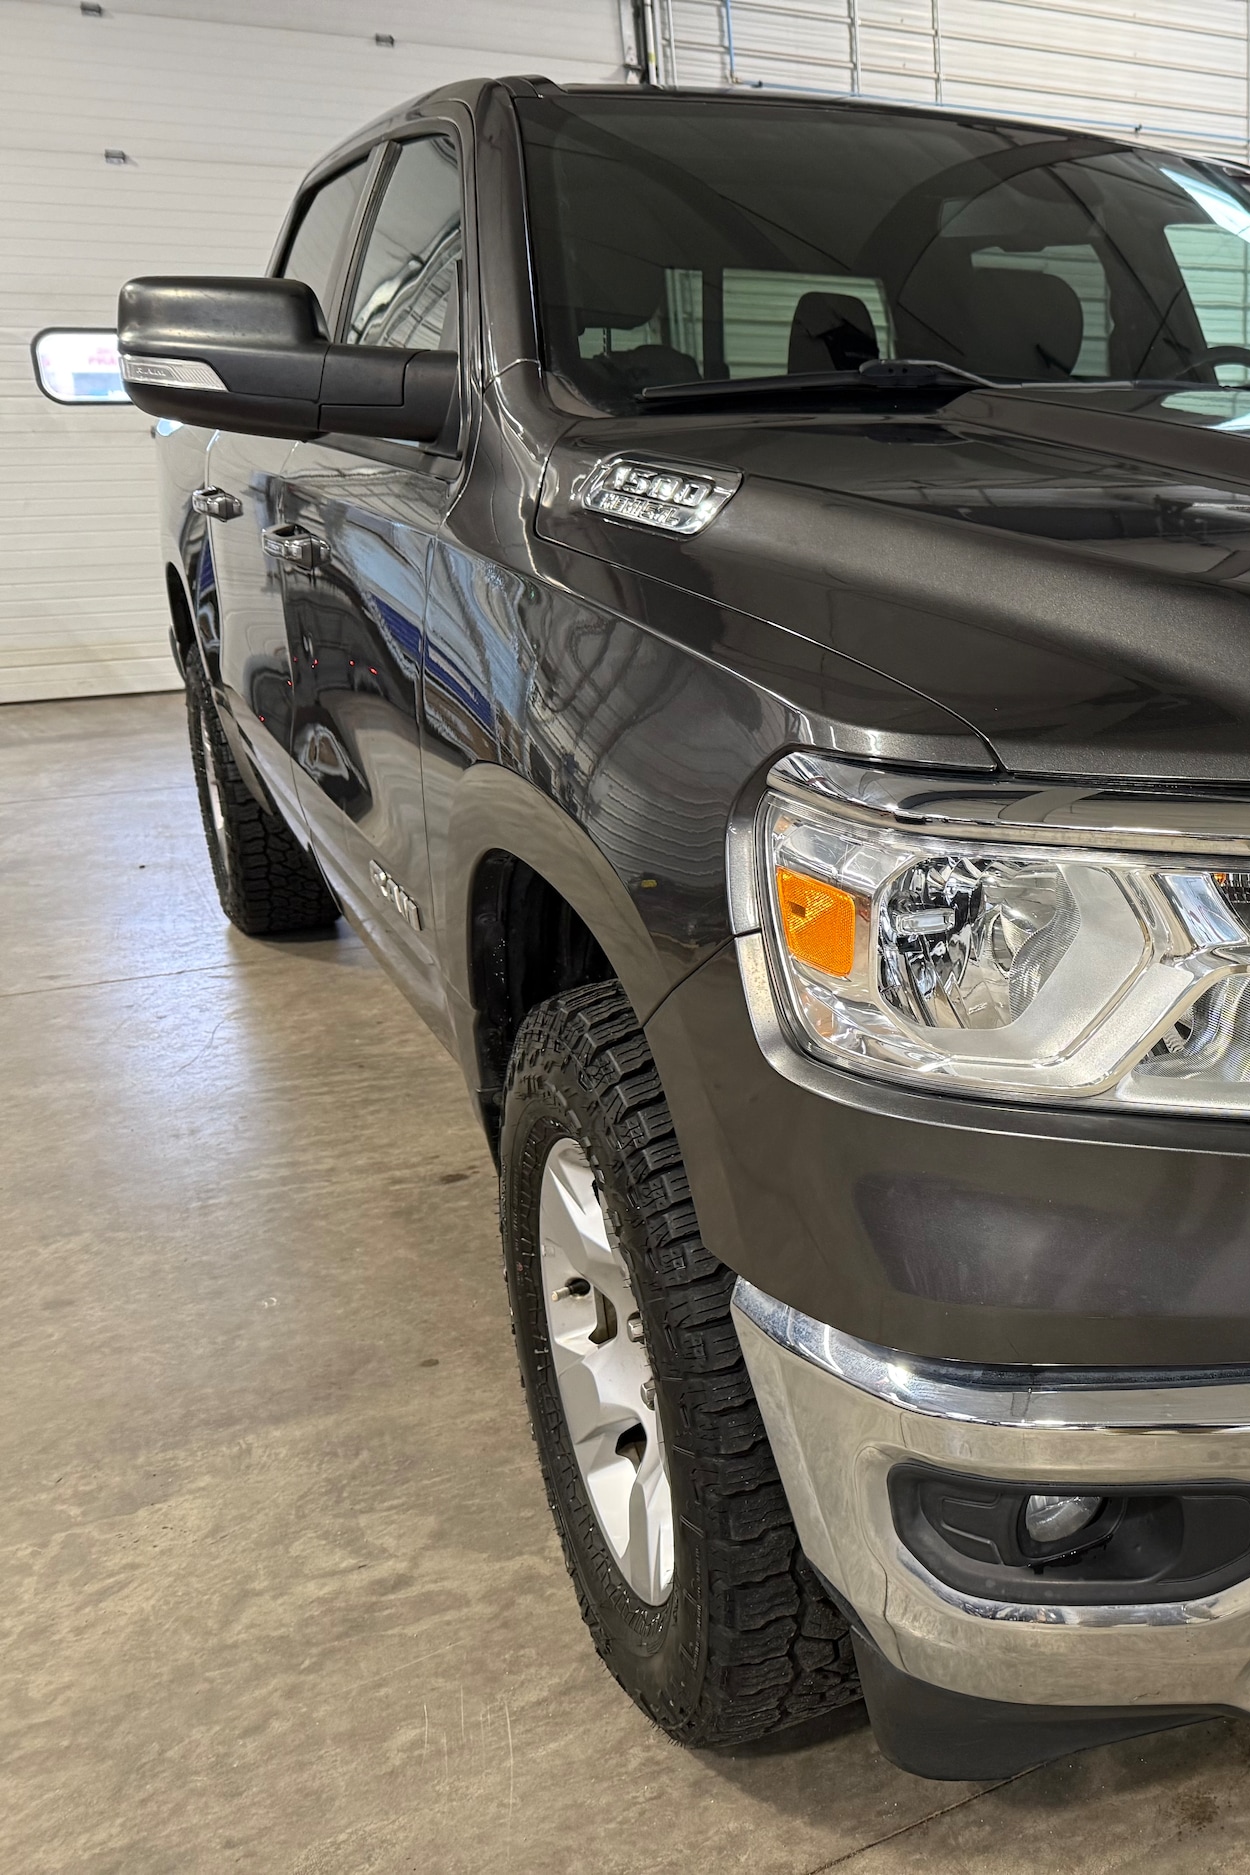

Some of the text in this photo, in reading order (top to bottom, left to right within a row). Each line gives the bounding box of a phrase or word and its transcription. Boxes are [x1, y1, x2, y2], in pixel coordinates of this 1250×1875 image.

[599, 492, 644, 518] HEMI
[613, 466, 712, 507] 1500
[369, 859, 422, 931] RAM
